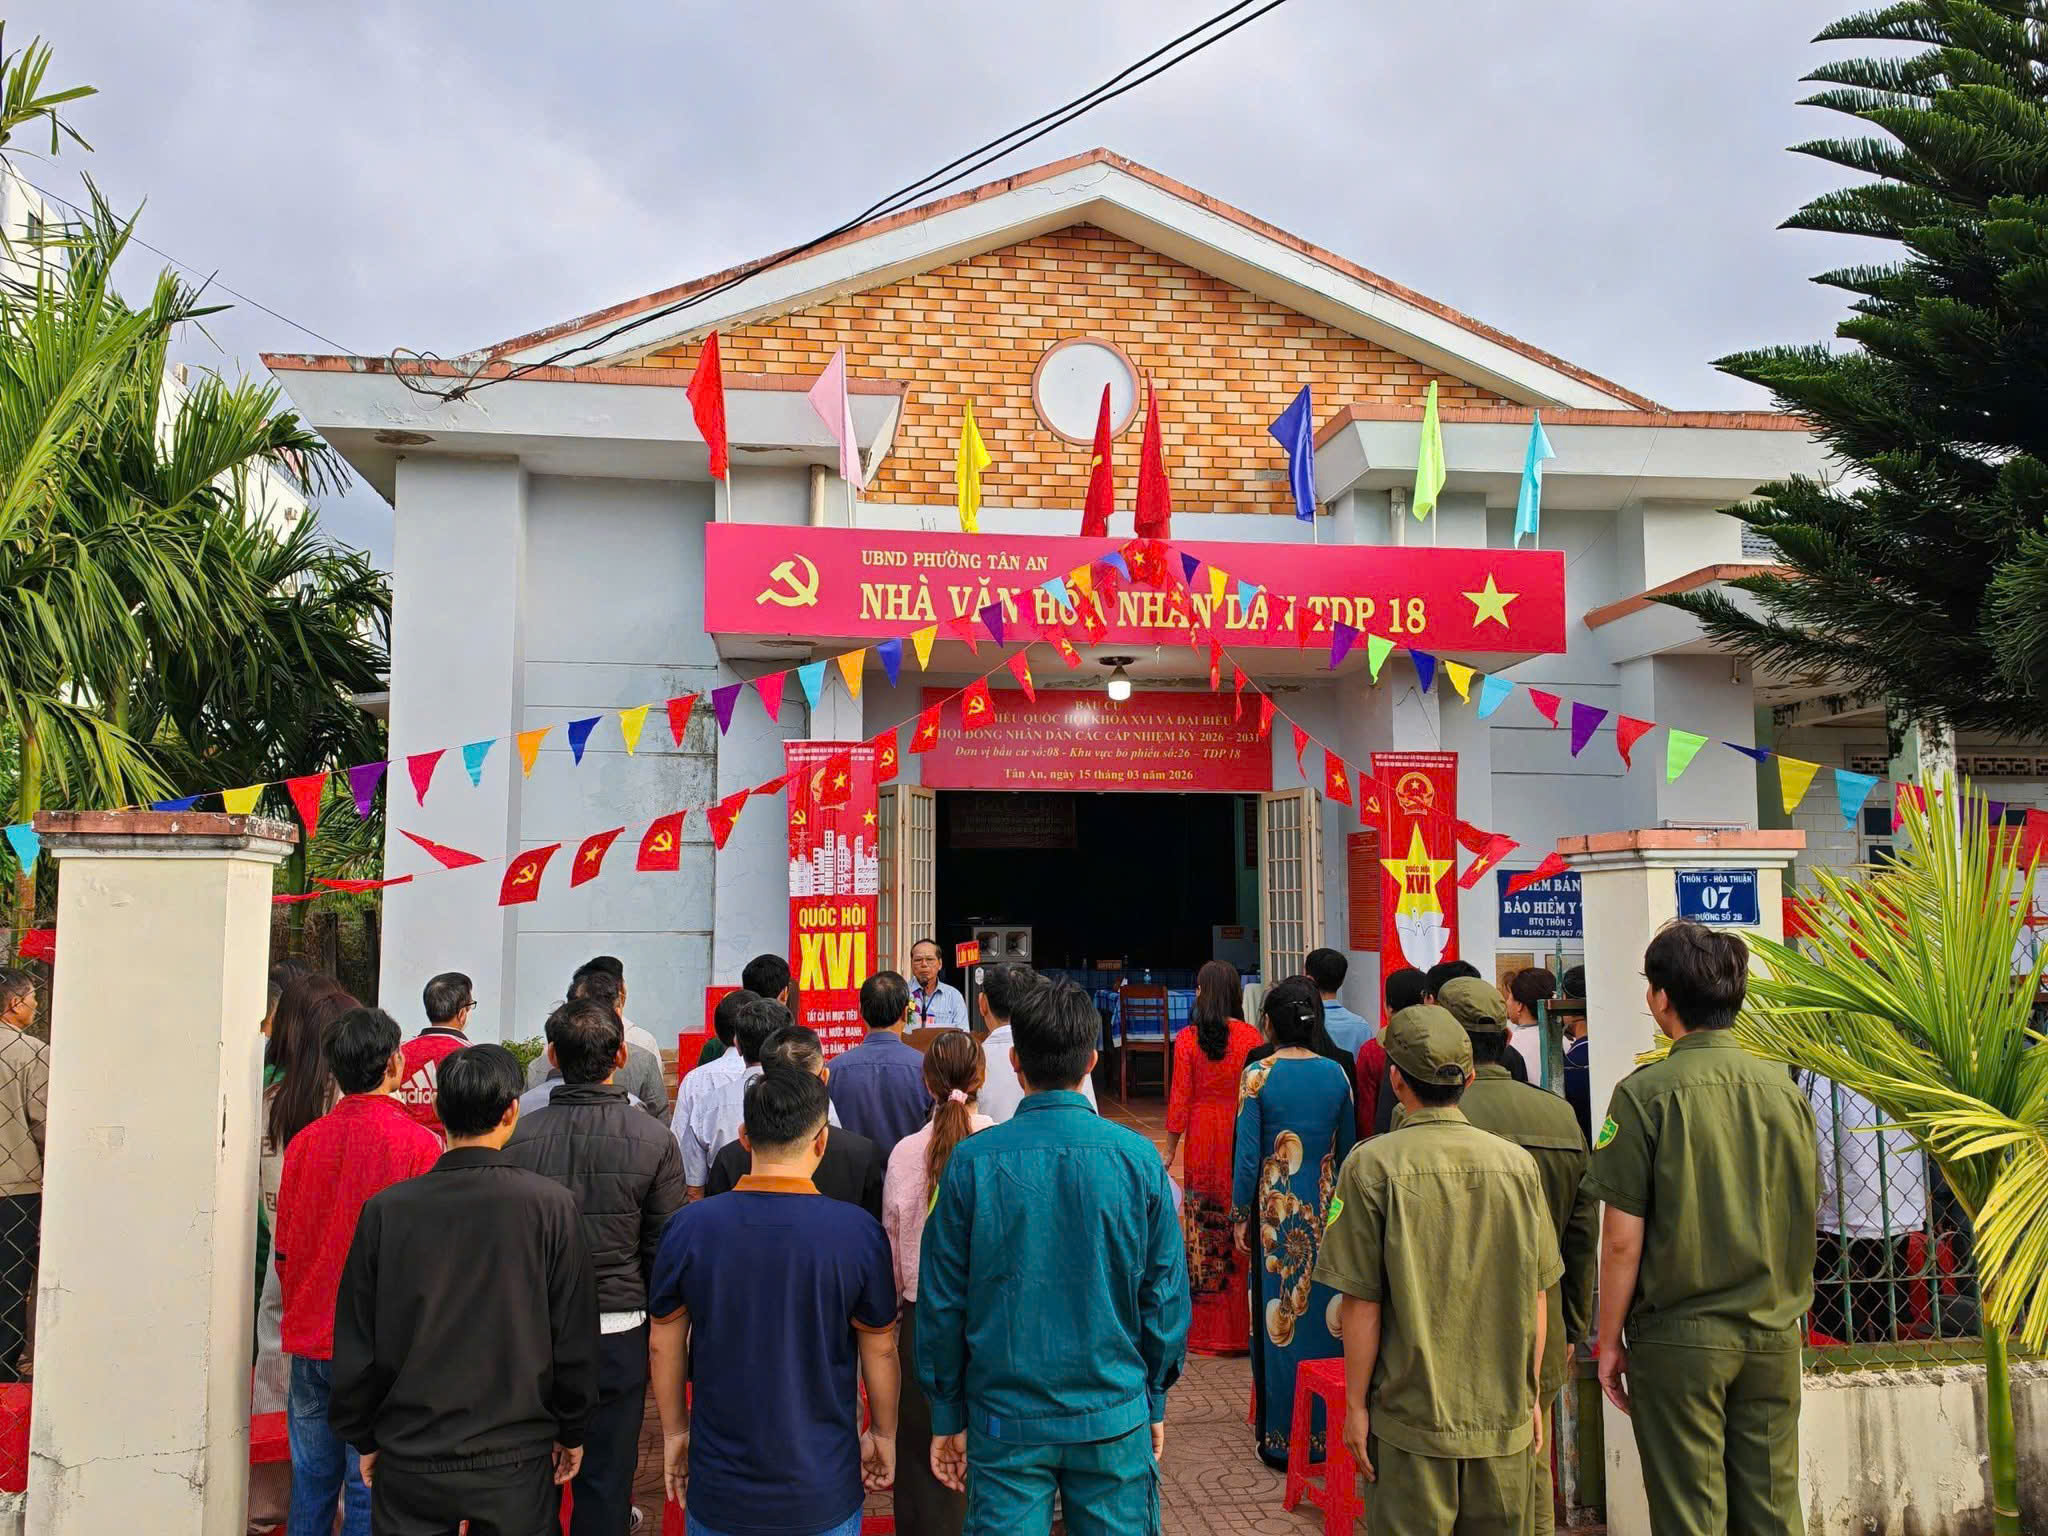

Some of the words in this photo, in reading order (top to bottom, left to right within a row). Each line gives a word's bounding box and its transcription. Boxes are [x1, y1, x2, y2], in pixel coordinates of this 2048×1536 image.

[861, 549, 908, 567] UBND
[913, 549, 982, 569] PHƯỜNG
[987, 551, 1021, 571] TÂN
[1025, 556, 1049, 571] AN
[859, 573, 937, 621] NHÀ
[947, 576, 1021, 625] VĂN
[1307, 595, 1376, 633] TDP
[1389, 597, 1427, 634] 18
[1131, 715, 1152, 725] XVI
[1156, 713, 1174, 725] VÀ
[1177, 715, 1198, 729] ĐẠI
[938, 729, 961, 741] HỘI
[1006, 727, 1042, 740] NHÂN
[1046, 727, 1072, 740] DÂN
[1075, 729, 1101, 741] CÁC
[1133, 731, 1175, 744] NHIỆM
[1200, 732, 1224, 742] 2026
[1236, 732, 1259, 743] 2031
[955, 745, 977, 757] Đơn
[980, 747, 991, 759] vị
[1069, 747, 1091, 758] Khu
[1094, 748, 1113, 760] vực
[1203, 748, 1227, 759] TDP
[1230, 749, 1241, 760] 18
[1004, 768, 1025, 779] Tân
[1050, 769, 1075, 782] ngày
[1079, 769, 1091, 780] 15
[1094, 769, 1125, 781] tháng
[1127, 770, 1140, 780] 03
[1142, 770, 1166, 780] năm
[1169, 770, 1193, 780] 2026
[1406, 874, 1431, 894] XVI
[1553, 875, 1581, 892] BÁN
[1682, 873, 1701, 883] THÔN
[1703, 875, 1708, 883] 5
[1729, 873, 1752, 885] THUẬN
[1503, 895, 1531, 914] BẢO
[1533, 895, 1566, 914] HIỂM
[1568, 902, 1577, 915] Y
[1701, 886, 1734, 910] 07
[799, 900, 837, 930] QUỐC
[841, 902, 867, 931] HỘI
[1567, 918, 1573, 927] 5
[799, 931, 867, 991] XVI
